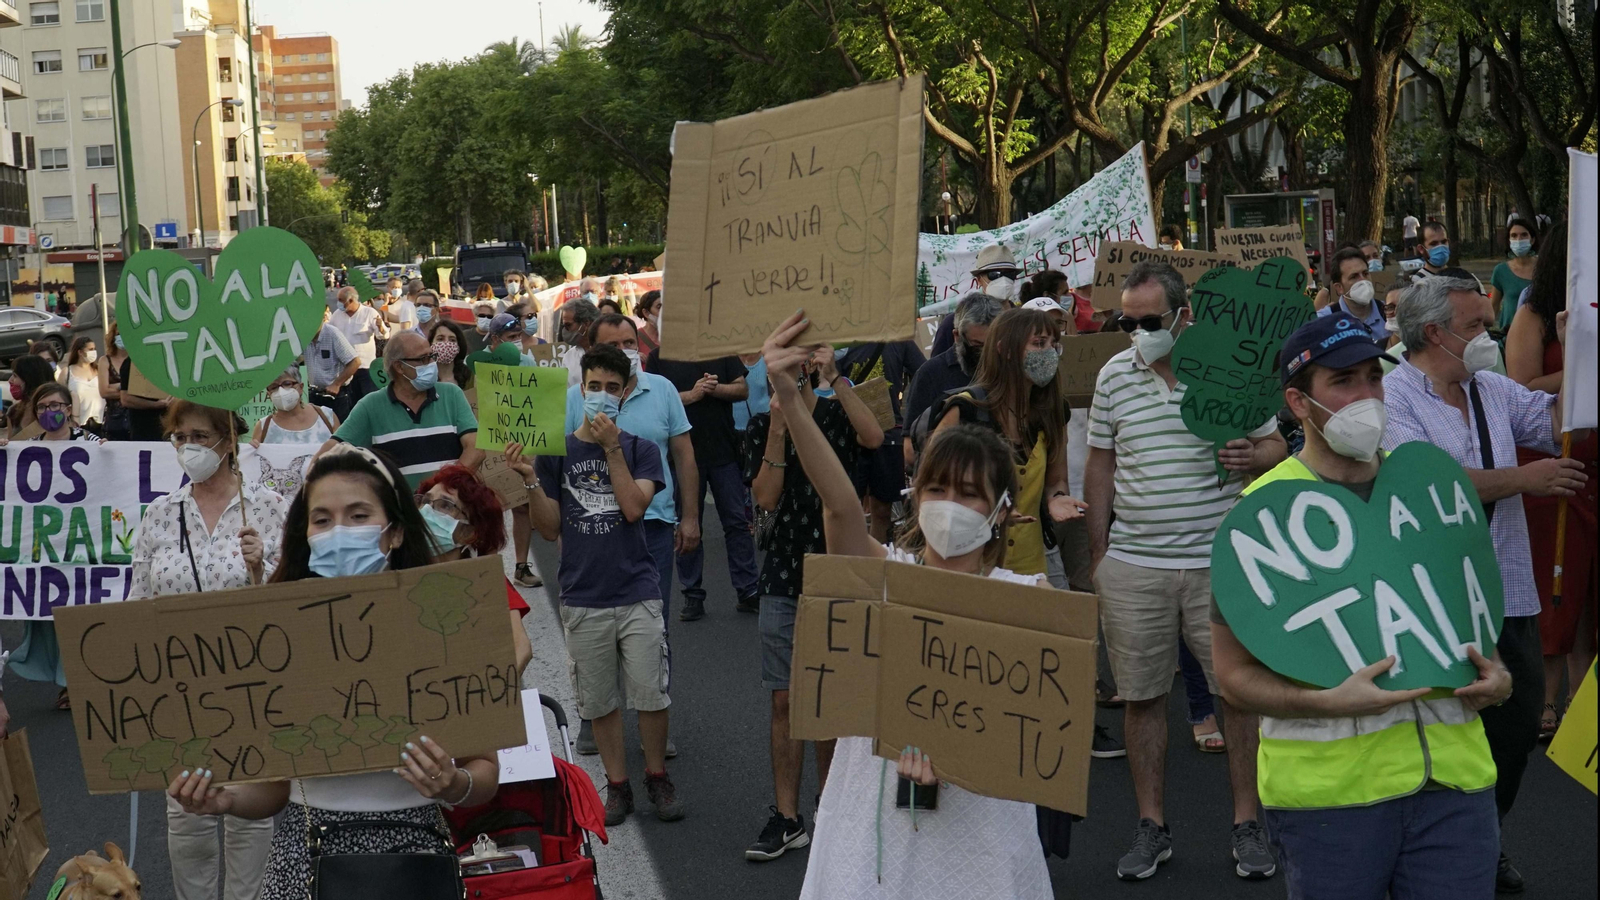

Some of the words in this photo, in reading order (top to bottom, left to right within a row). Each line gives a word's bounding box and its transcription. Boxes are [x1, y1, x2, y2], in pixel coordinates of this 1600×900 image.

[788, 145, 824, 180] AL
[161, 226, 171, 237] L
[1221, 232, 1266, 246] NUESTRA
[1107, 247, 1123, 264] SI
[1241, 246, 1294, 261] NECESITA
[1094, 271, 1116, 288] LA
[1255, 262, 1290, 290] EL
[127, 267, 200, 326] NO
[221, 269, 251, 304] A
[260, 259, 314, 299] LA
[143, 307, 303, 388] TALA
[1231, 340, 1274, 370] SÍ
[491, 369, 504, 386] NO
[505, 371, 514, 388] A
[519, 372, 538, 388] LA
[494, 391, 534, 409] TALA
[497, 412, 511, 428] NO
[516, 412, 537, 428] AL
[0, 446, 90, 504] OS
[578, 521, 591, 535] THE
[594, 521, 611, 535] SEA
[1230, 490, 1355, 607] NO
[1389, 494, 1421, 541] A
[1428, 480, 1478, 526] LA
[1283, 556, 1498, 678] TALA
[80, 621, 292, 685] CUANDO
[298, 594, 375, 663] TÚ
[827, 600, 881, 659] EL
[912, 615, 1070, 706] TALADOR
[332, 679, 381, 719] YA
[405, 664, 519, 727] ESTABA
[905, 685, 986, 733] ERES
[1003, 711, 1072, 781] TÚ
[213, 745, 265, 780] YO
